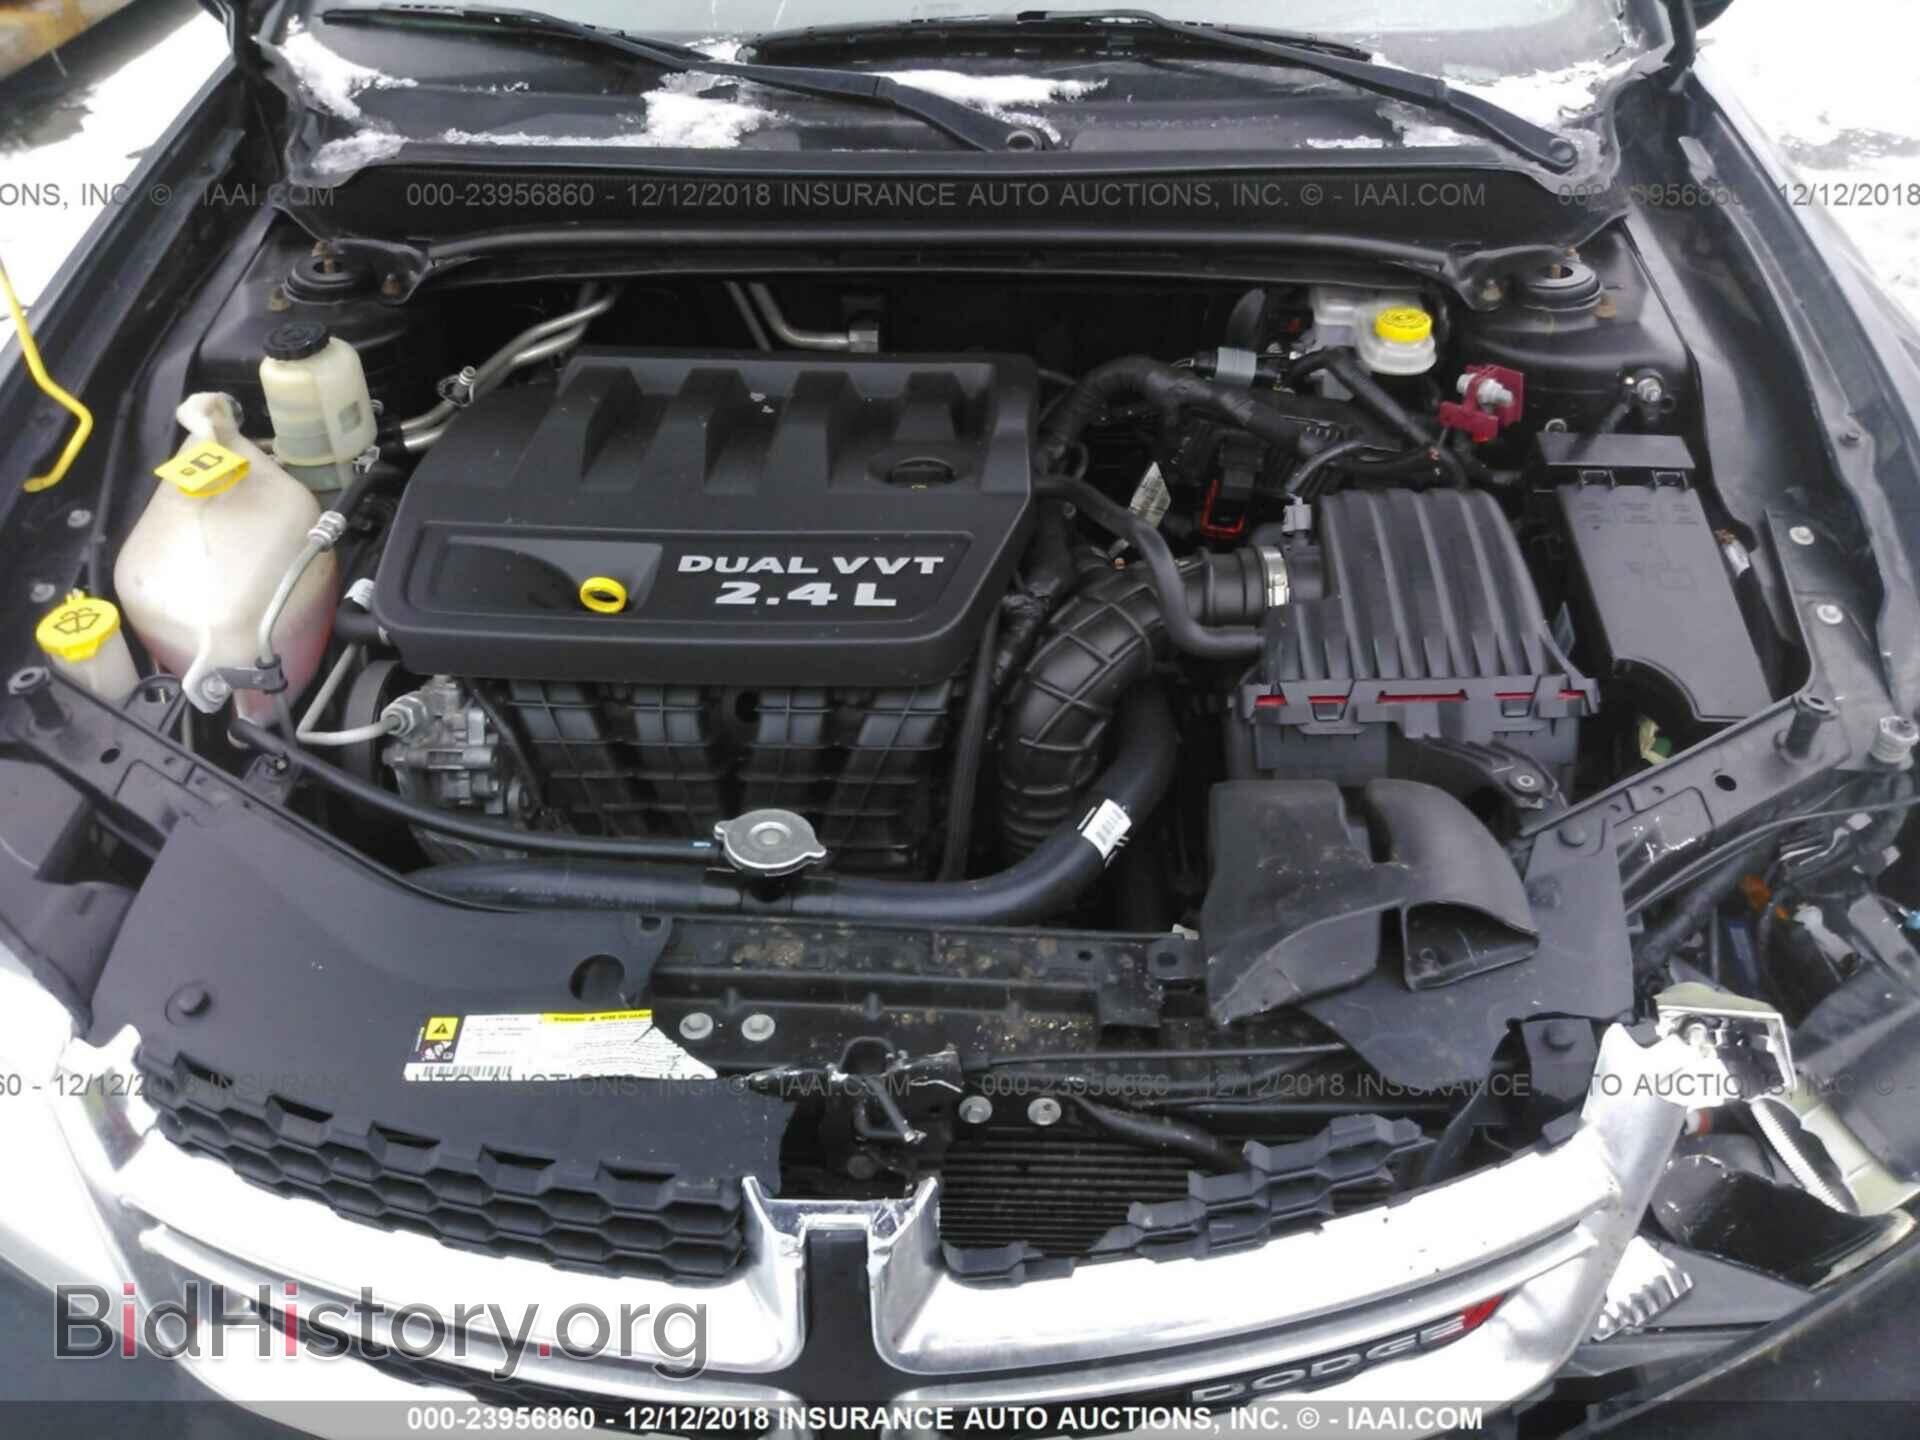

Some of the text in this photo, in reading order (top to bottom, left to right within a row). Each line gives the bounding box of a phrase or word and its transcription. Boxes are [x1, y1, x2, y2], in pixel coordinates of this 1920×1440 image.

[678, 555, 945, 574] DUAL VVT
[715, 581, 897, 606] 2.4 L
[1191, 1314, 1466, 1402] DODGE
